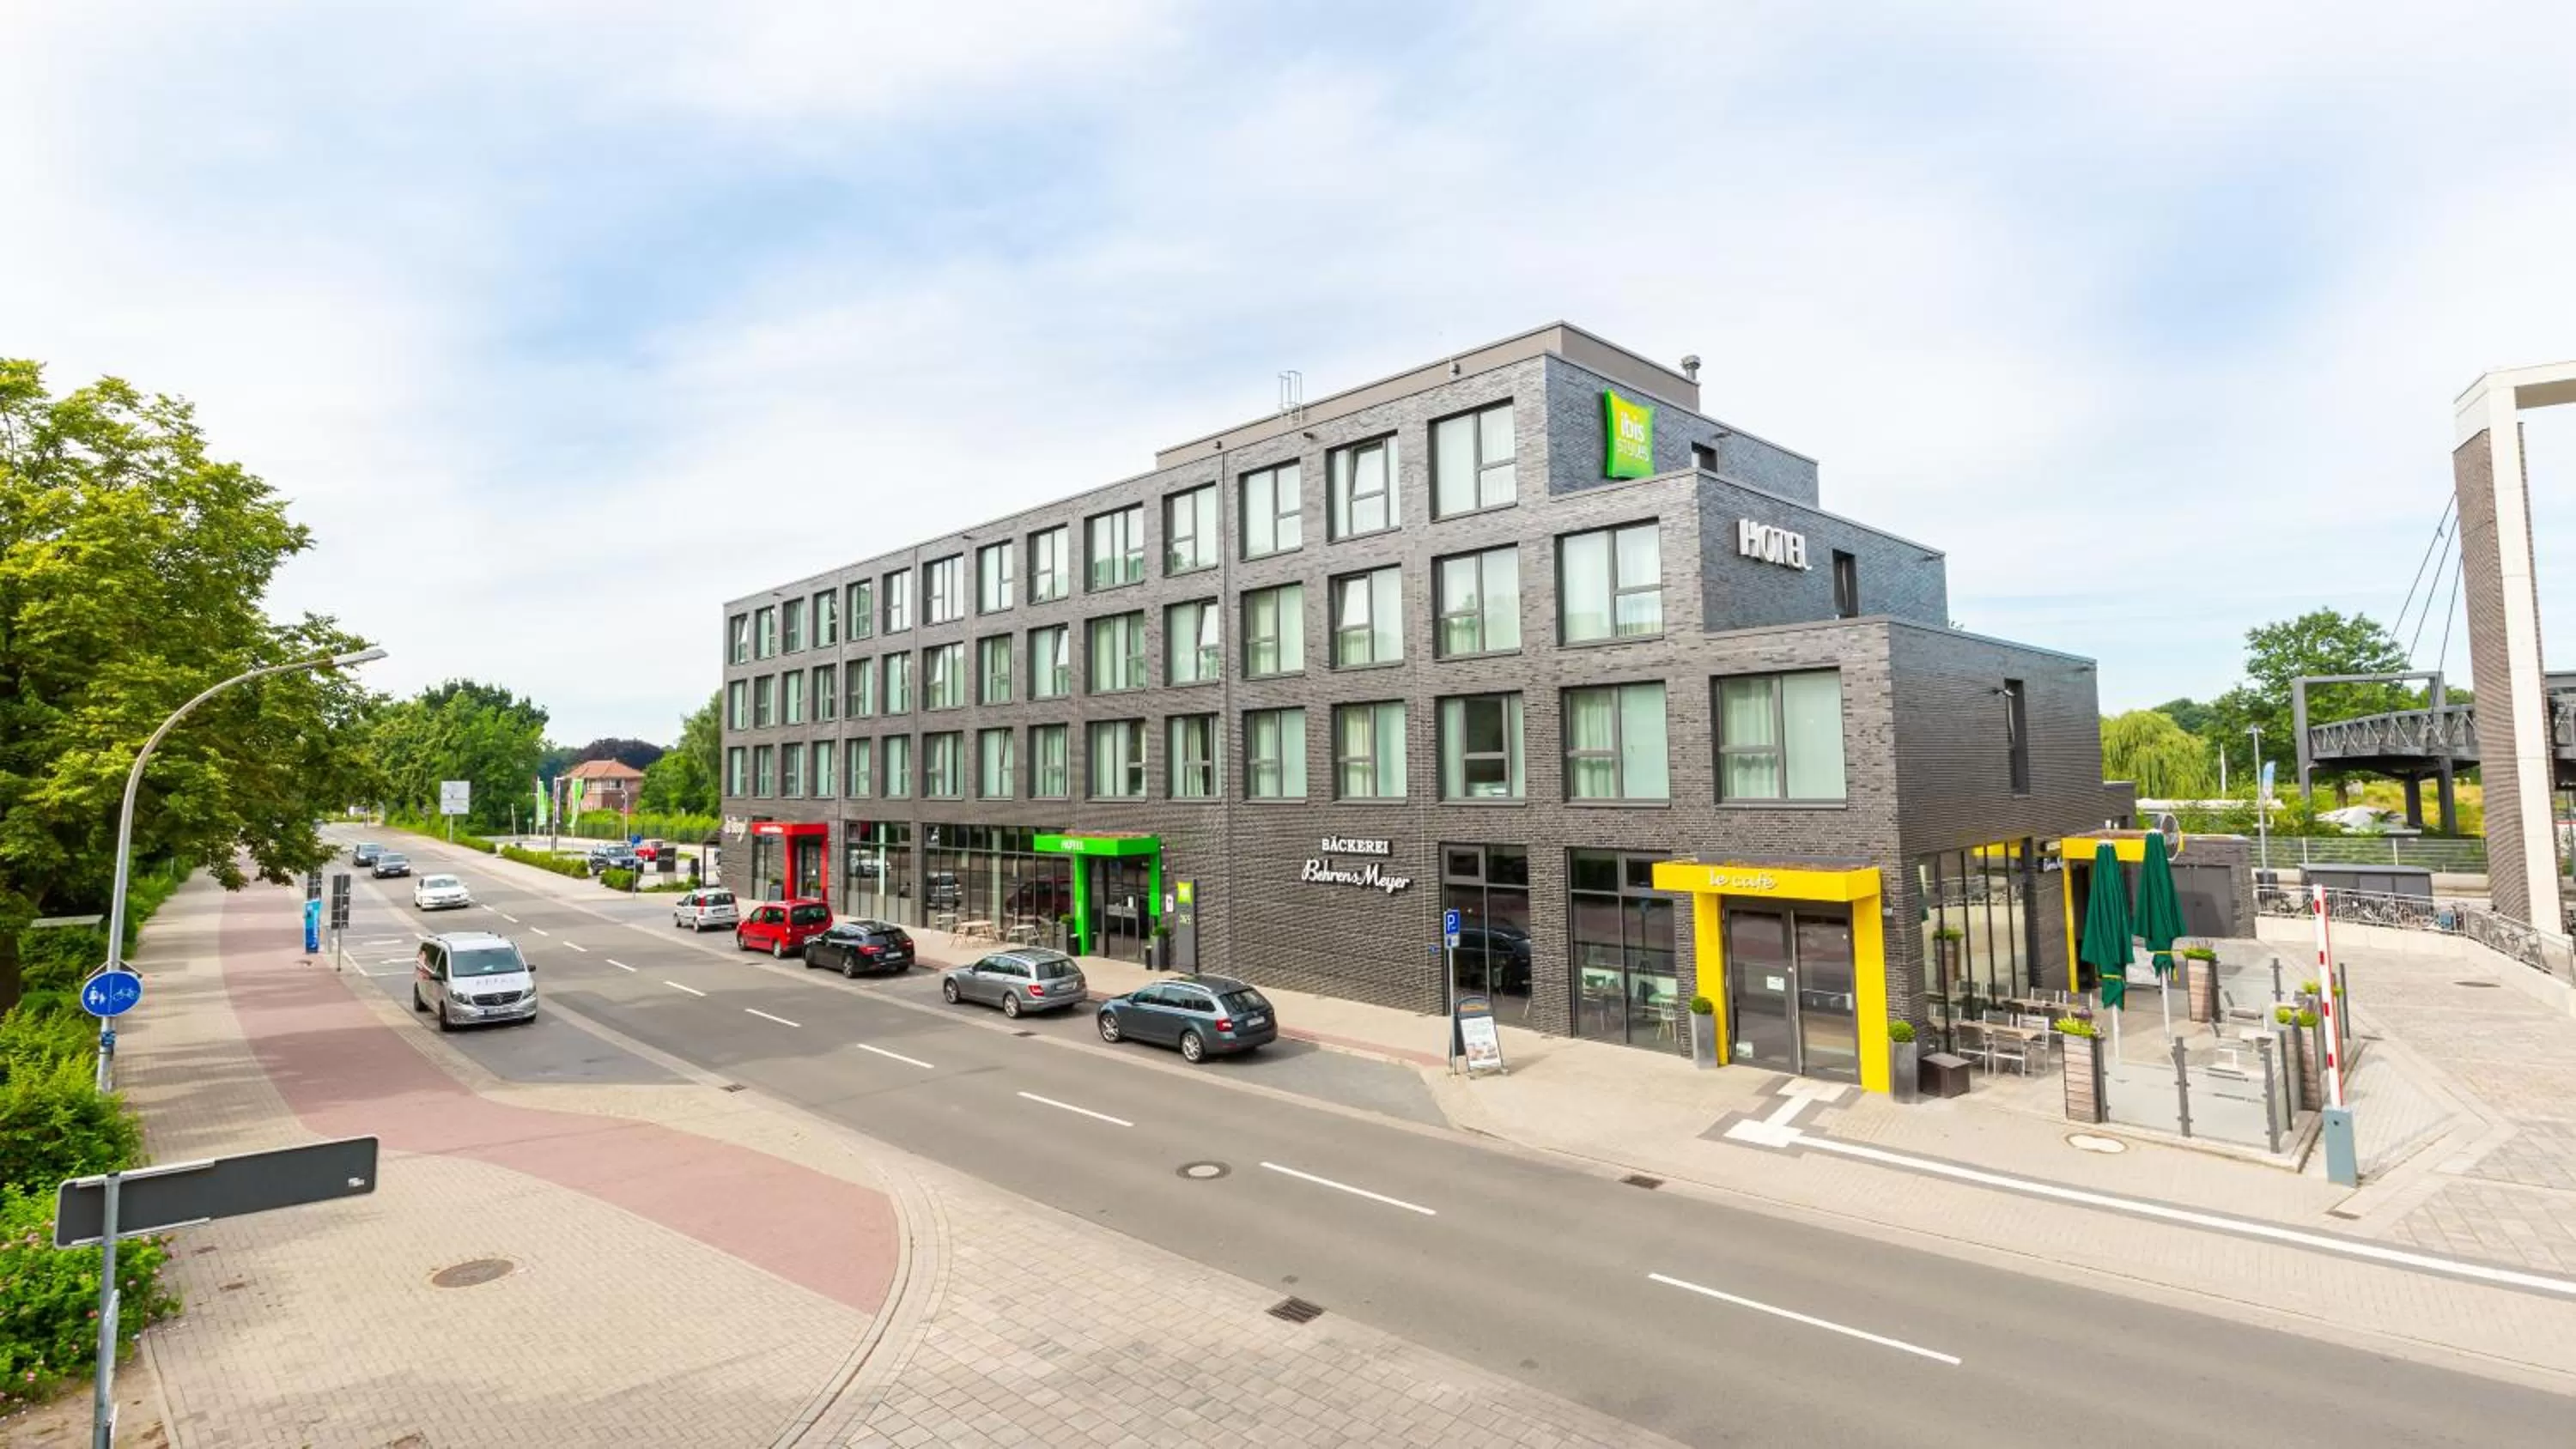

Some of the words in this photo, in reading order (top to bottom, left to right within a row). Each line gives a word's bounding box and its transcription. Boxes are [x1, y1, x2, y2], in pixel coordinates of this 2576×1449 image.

[1620, 411, 1644, 441] ibis
[1739, 518, 1813, 570] HOTEL
[1321, 835, 1389, 854] BÄCKEREI
[1710, 866, 1728, 886] le
[1447, 914, 1455, 932] P
